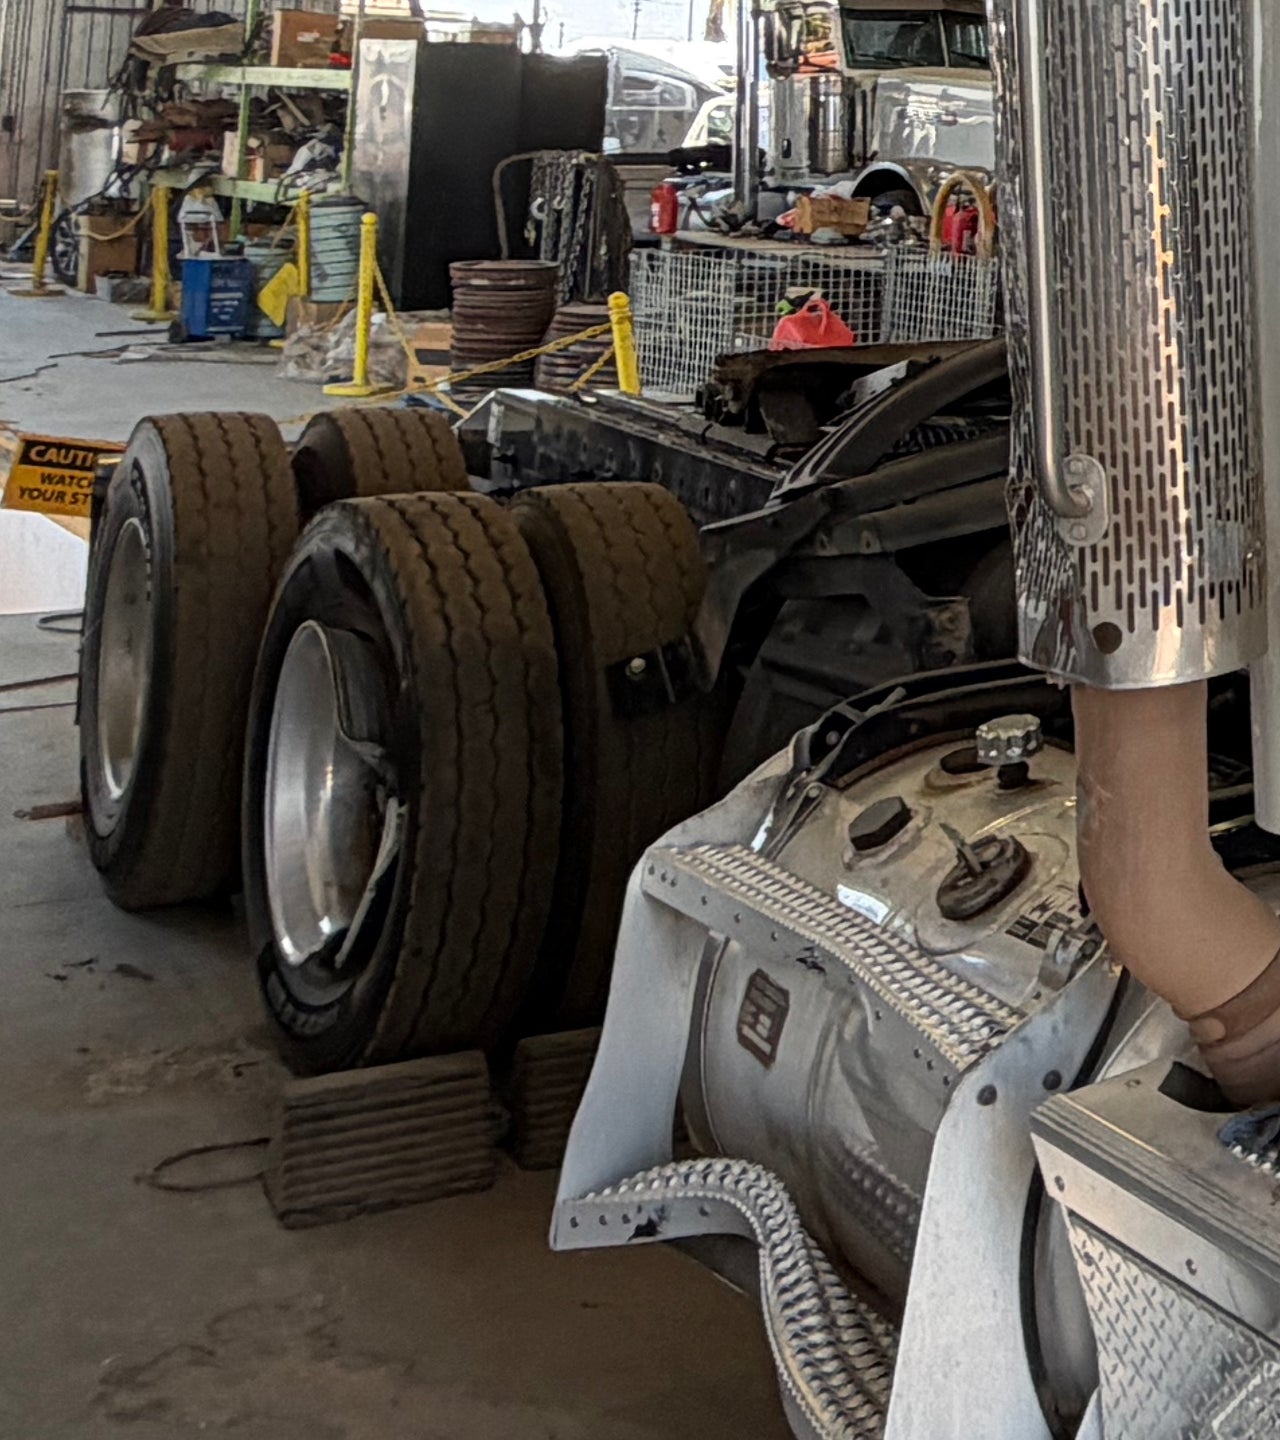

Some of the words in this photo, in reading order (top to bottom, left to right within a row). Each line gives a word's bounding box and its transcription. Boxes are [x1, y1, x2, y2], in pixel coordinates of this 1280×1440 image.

[30, 446, 94, 466] CAUTI
[18, 486, 67, 504] YOUR
[69, 492, 92, 505] ST
